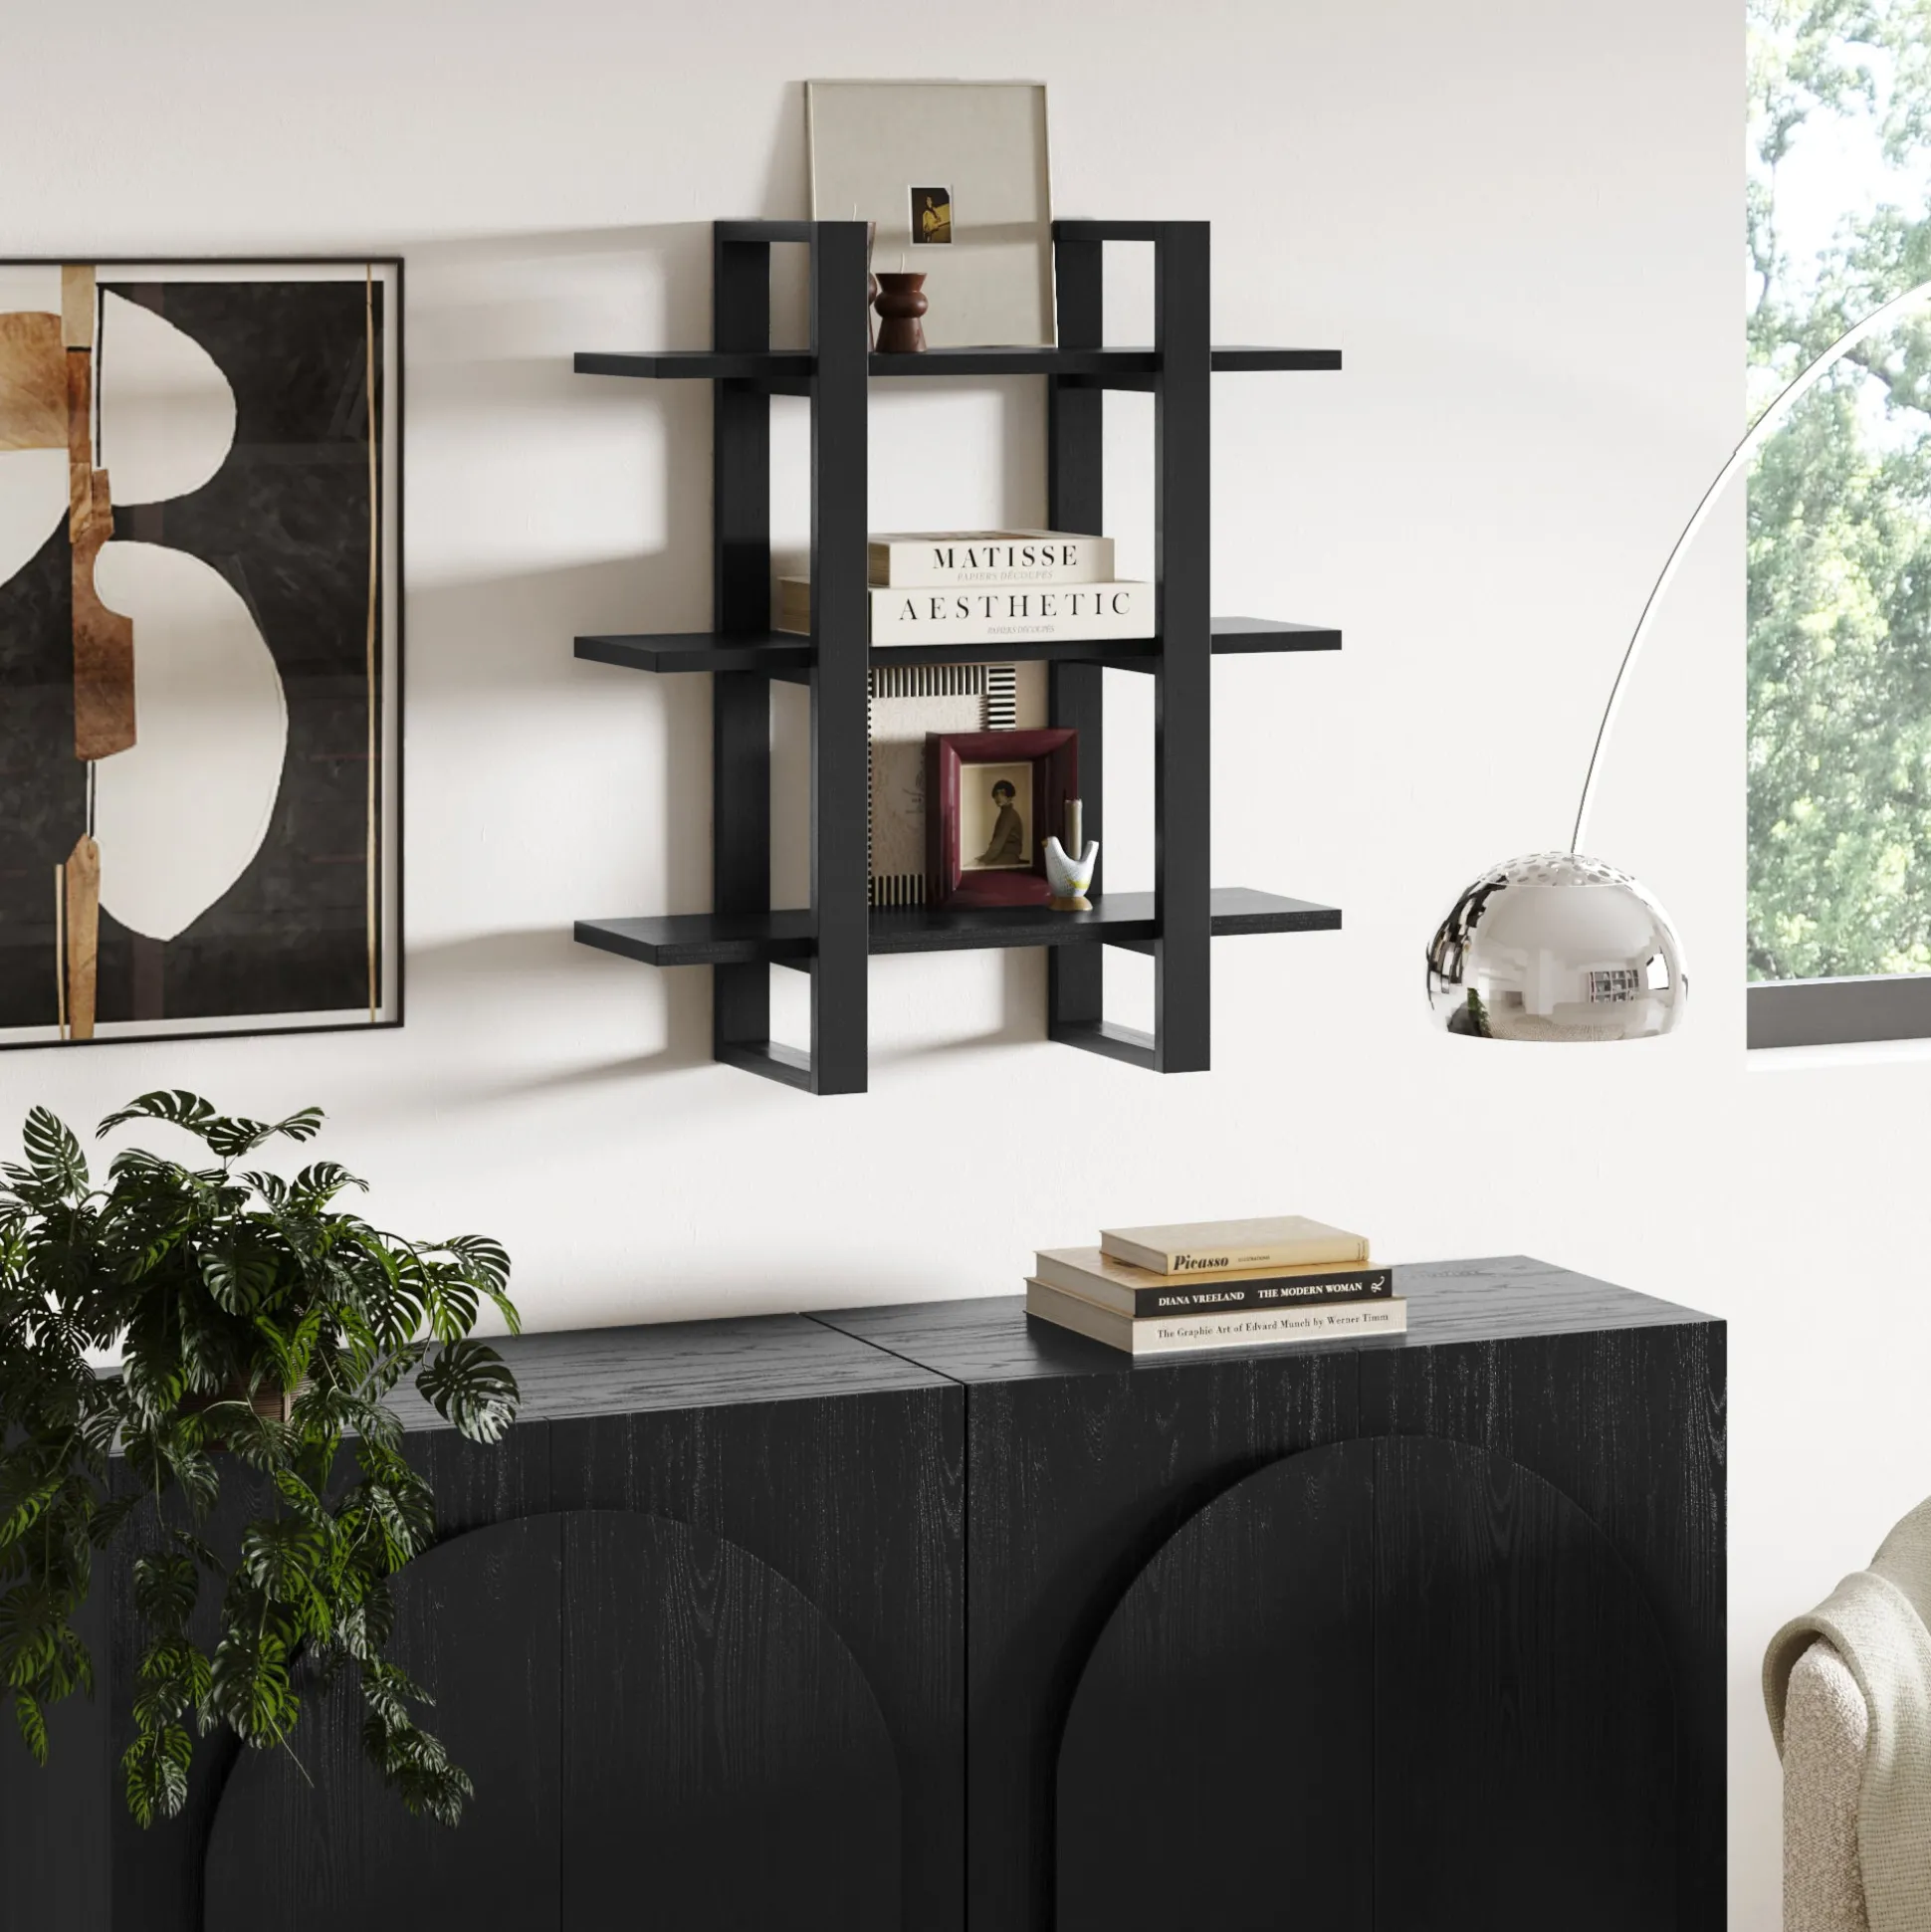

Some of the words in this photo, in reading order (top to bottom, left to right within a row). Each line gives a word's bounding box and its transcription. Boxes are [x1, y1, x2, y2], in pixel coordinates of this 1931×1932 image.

[933, 545, 1077, 569] MATISSE
[899, 591, 1131, 621] AESTHETIC
[1173, 1254, 1229, 1270] Picasso
[1159, 1297, 1189, 1306] DIANA
[1192, 1292, 1244, 1303] VREELAND
[1258, 1288, 1279, 1299] THE
[1280, 1285, 1323, 1297] MODERN
[1326, 1282, 1363, 1293] WOMAN
[1158, 1329, 1174, 1338] The
[1177, 1327, 1212, 1338] Graphic
[1234, 1323, 1243, 1332] of
[1245, 1321, 1277, 1331] Edvard
[1280, 1319, 1310, 1328] Munch
[1313, 1317, 1322, 1329] by
[1327, 1315, 1359, 1324] Werner
